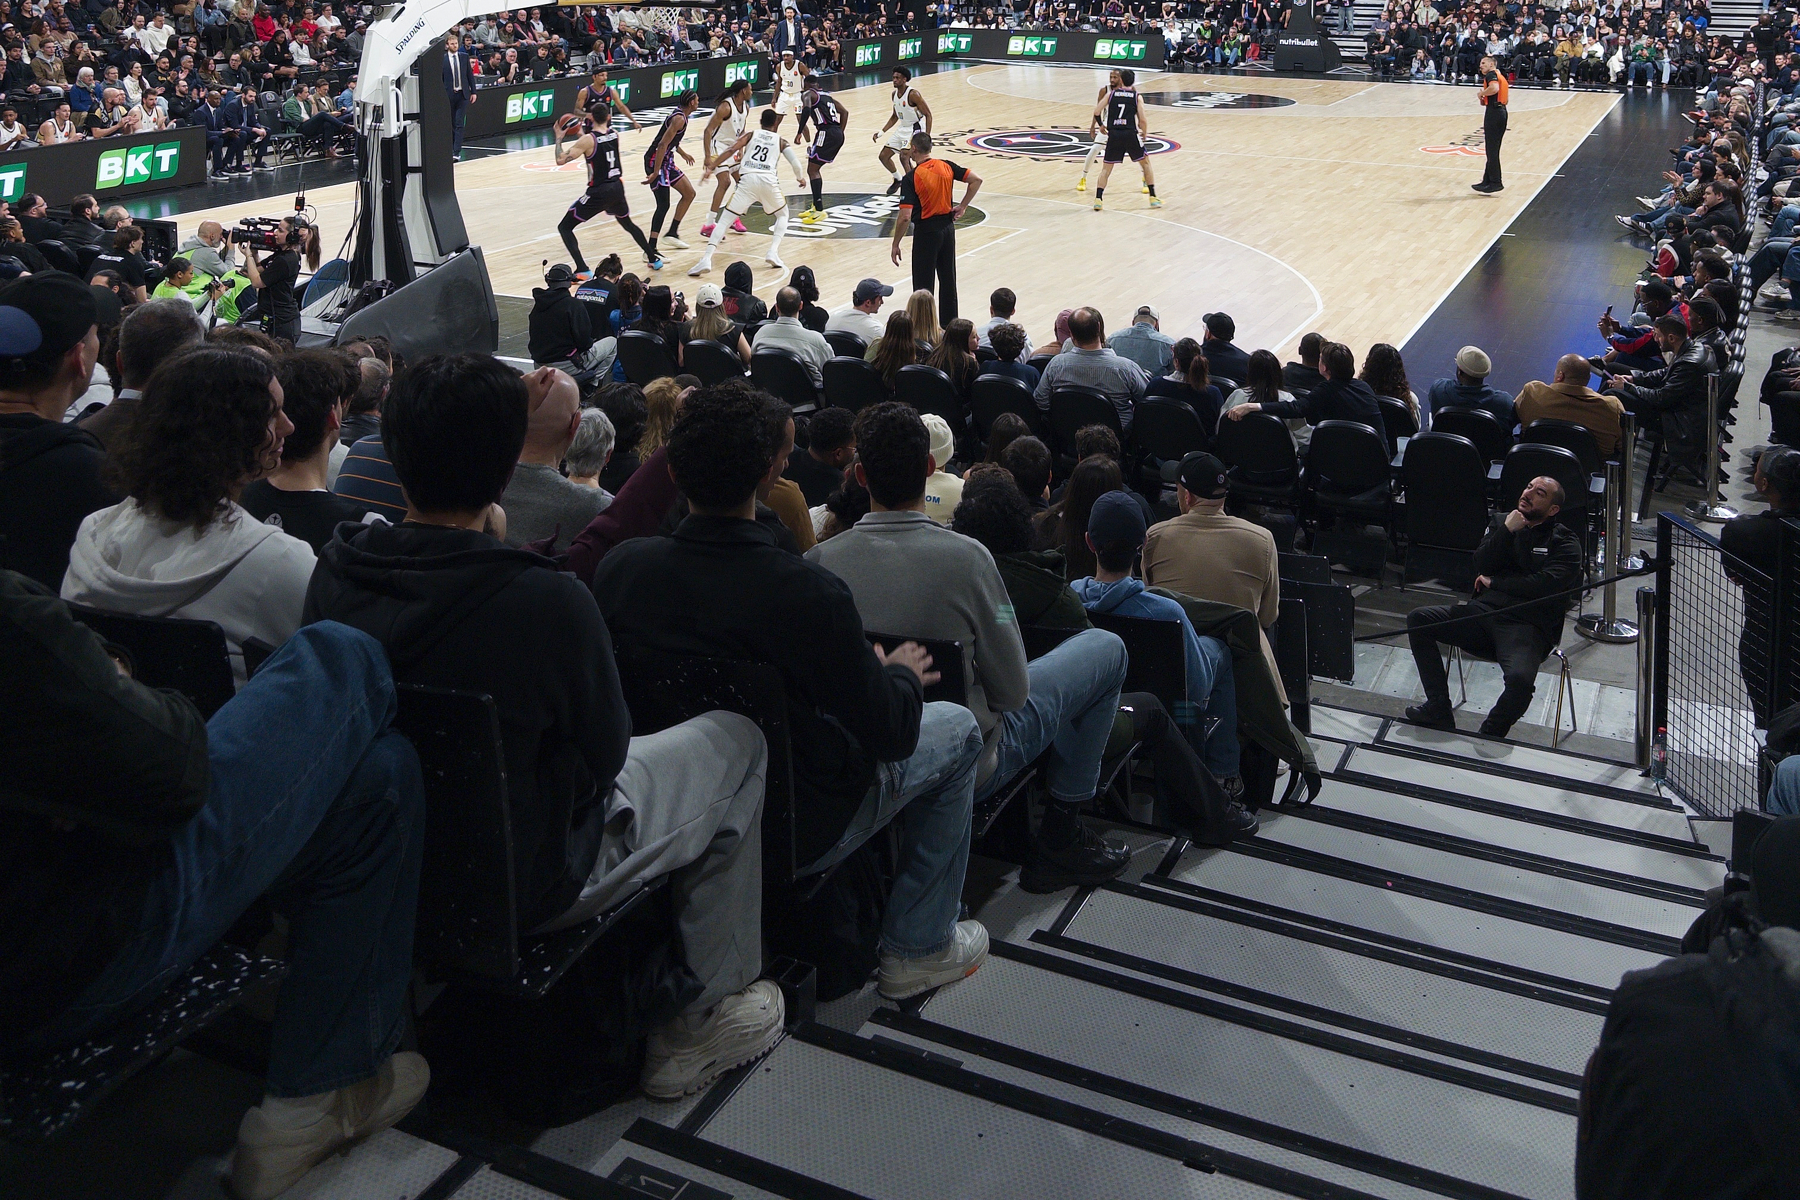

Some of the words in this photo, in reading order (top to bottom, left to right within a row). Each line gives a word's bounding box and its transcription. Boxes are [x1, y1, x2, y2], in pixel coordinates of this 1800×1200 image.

[395, 17, 425, 55] SPALDING
[938, 34, 971, 50] BKT
[856, 46, 881, 64] BKT
[899, 41, 921, 57] BKT
[1008, 39, 1056, 53] BKT
[1095, 42, 1146, 57] BKT
[726, 65, 758, 84] BKT
[661, 73, 698, 95] BKT
[506, 94, 553, 123] BKT
[1118, 104, 1126, 119] 7
[606, 151, 616, 169] 4
[751, 144, 769, 162] 23
[99, 148, 177, 182] BKT
